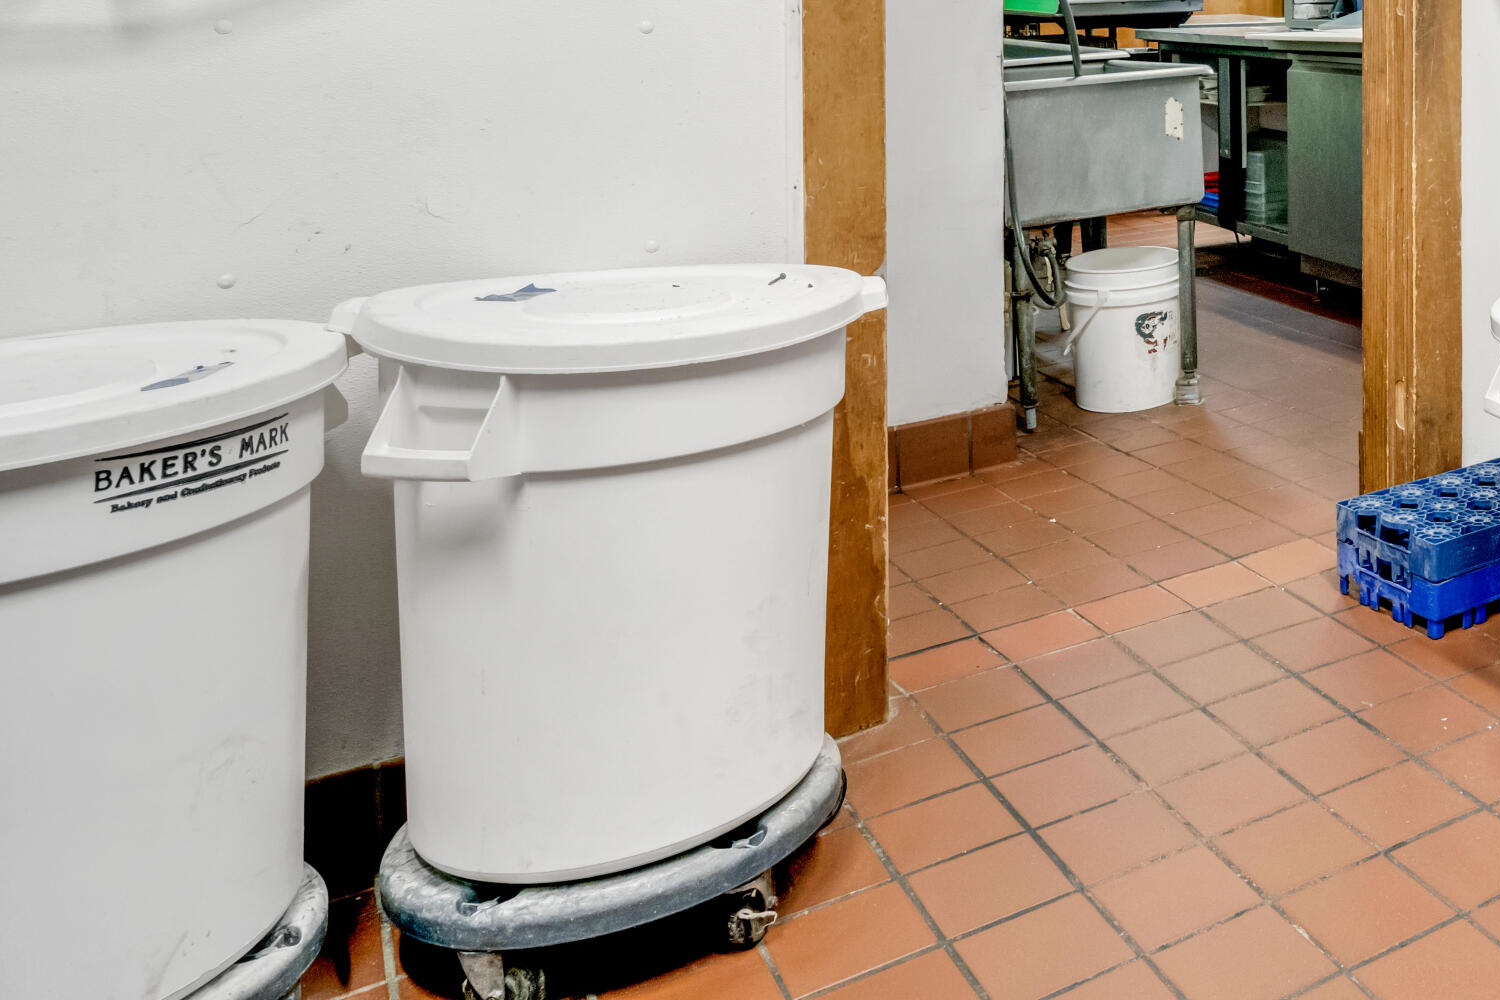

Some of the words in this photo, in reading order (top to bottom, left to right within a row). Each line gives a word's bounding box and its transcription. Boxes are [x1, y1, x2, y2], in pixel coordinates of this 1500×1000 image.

[94, 445, 222, 492] BAKER'S
[238, 423, 289, 459] MARK
[110, 496, 153, 513] Bakery
[156, 490, 178, 503] and
[248, 461, 281, 479] Products
